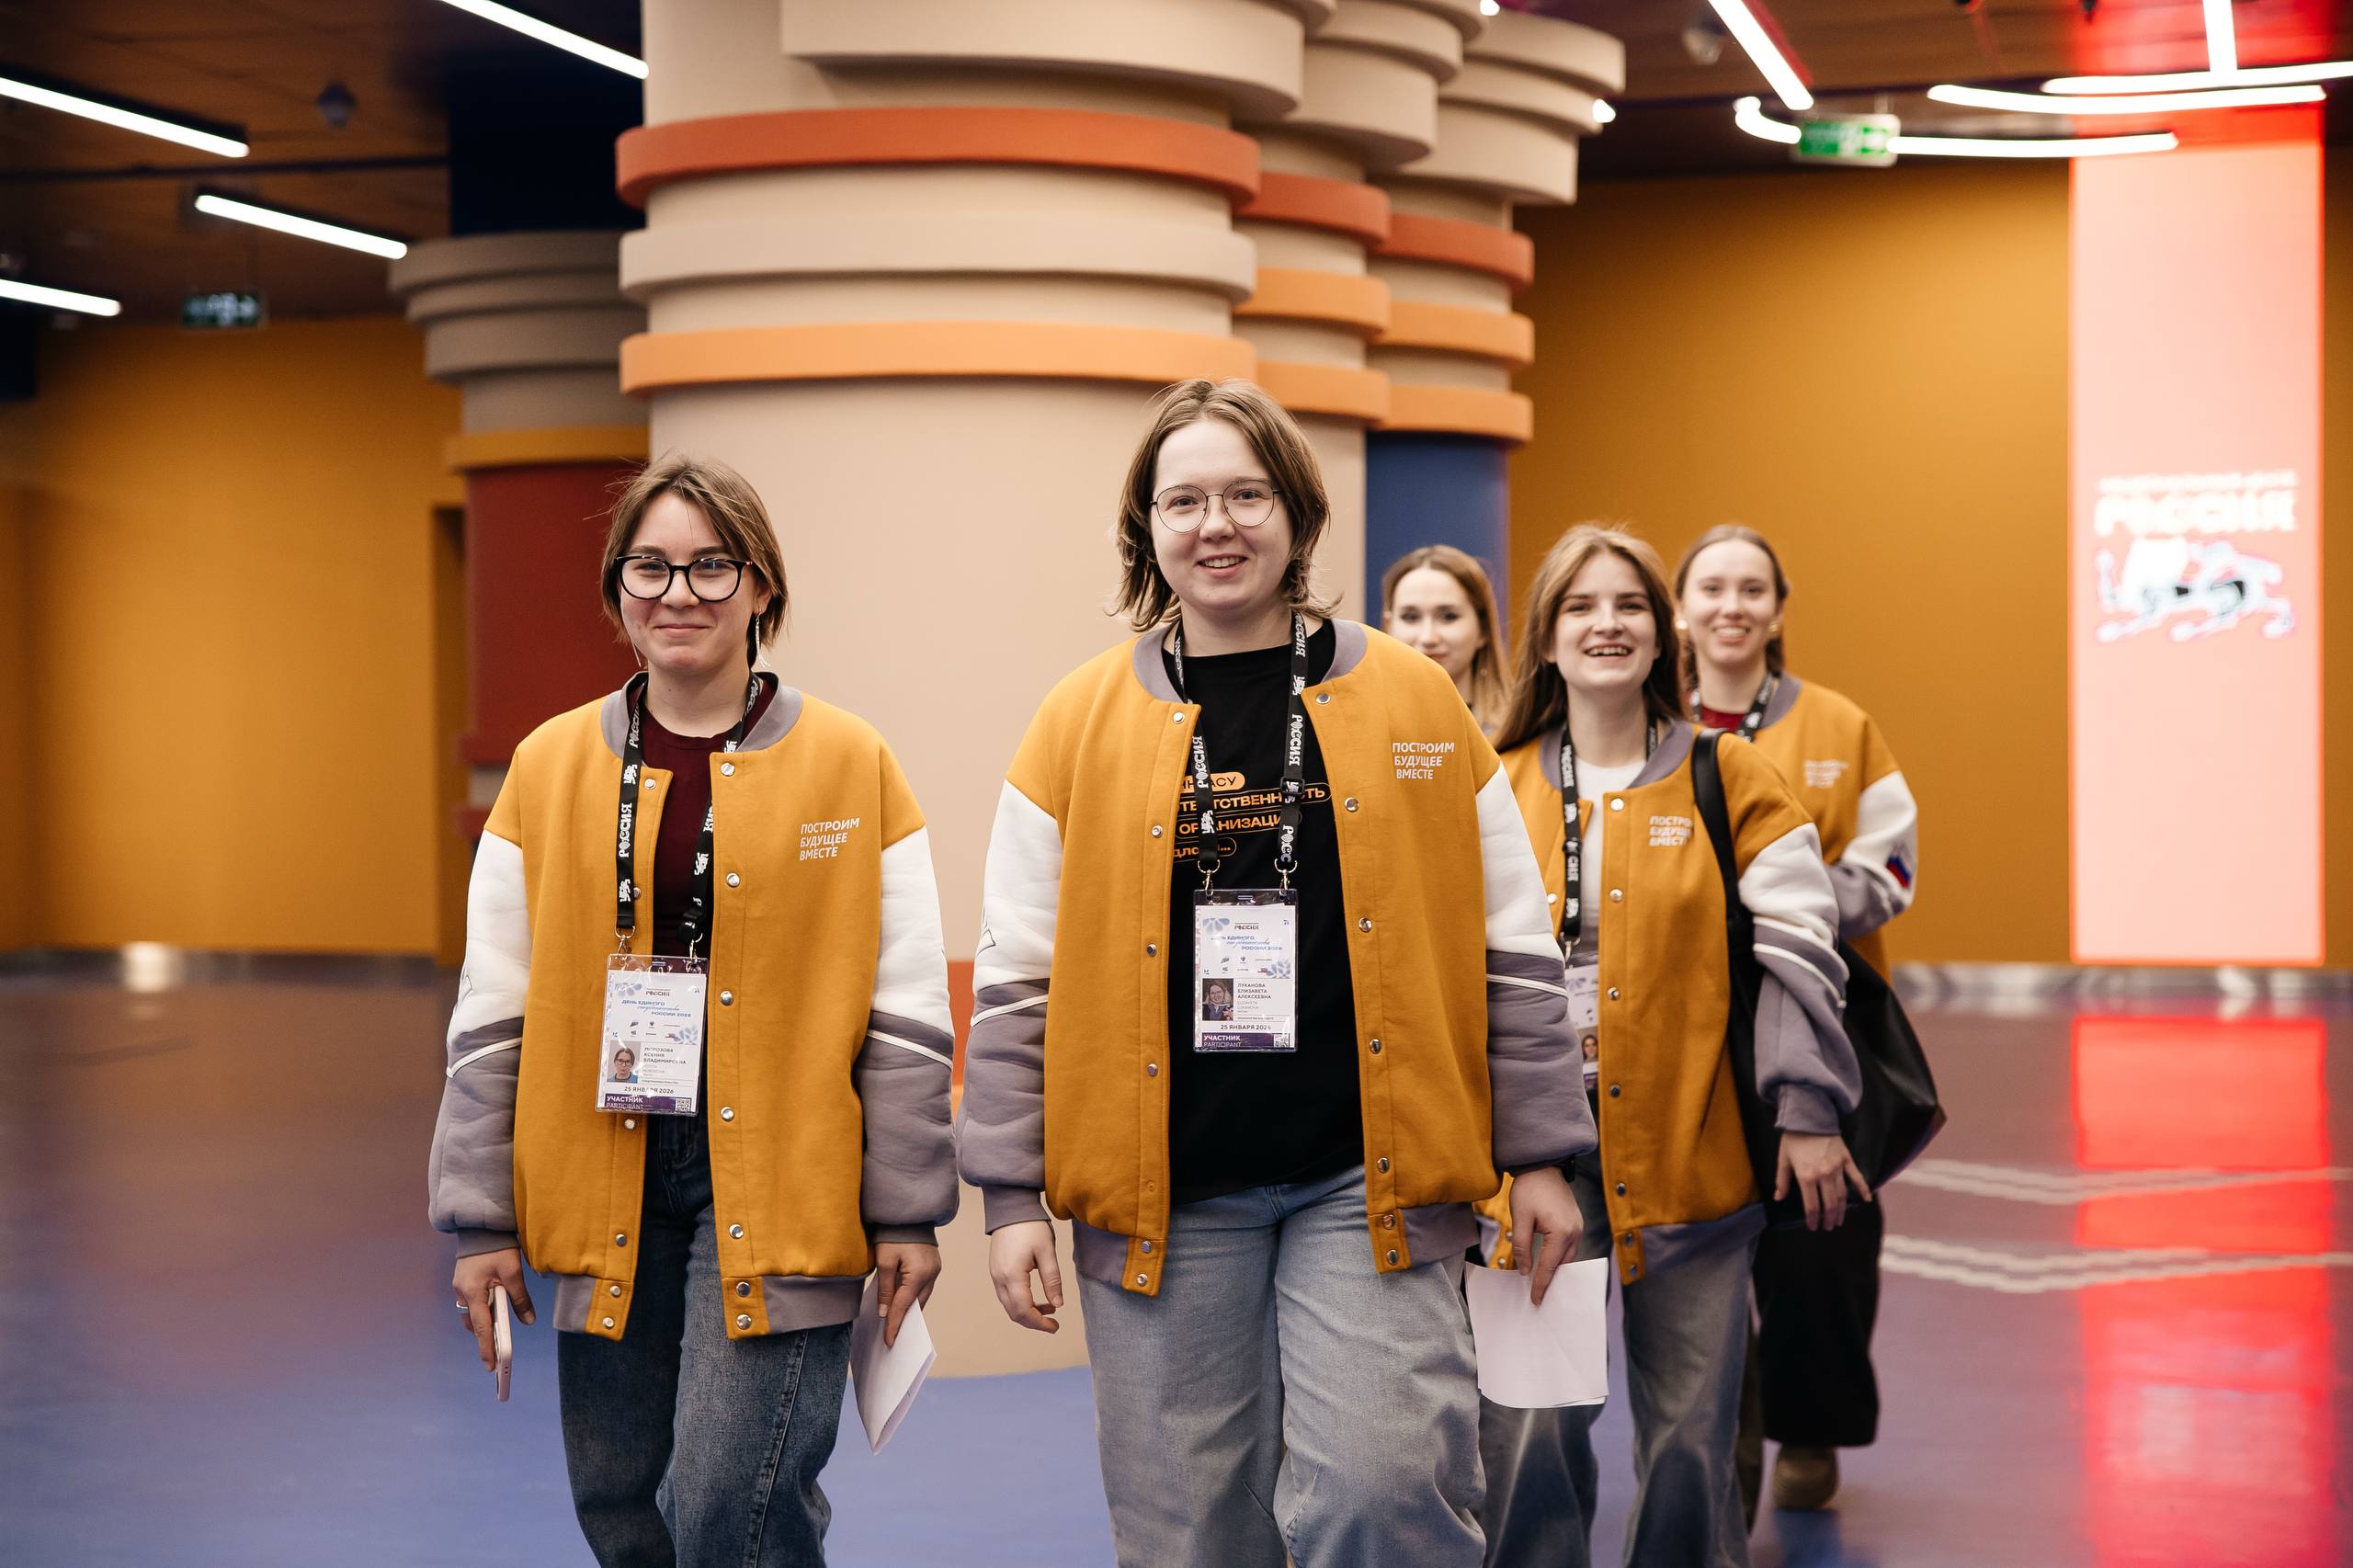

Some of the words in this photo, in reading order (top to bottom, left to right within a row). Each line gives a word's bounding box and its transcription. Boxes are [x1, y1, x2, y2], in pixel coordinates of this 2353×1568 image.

[1294, 613, 1306, 657] ОССИЯ
[629, 701, 641, 748] РОССИ
[1289, 714, 1303, 766] РОССИЯ
[1392, 742, 1455, 754] ПОСТРОИМ
[1194, 735, 1210, 789] РОССИЯ
[1394, 756, 1443, 768] БУДУЩЕЕ
[1396, 768, 1434, 779] ВМЕСТЕ
[619, 803, 632, 858] РОССИЯ
[801, 817, 860, 834] ПОСТРОИМ
[800, 833, 848, 848] БУДУЩЕЕ
[799, 846, 839, 860] ВМЕСТЕ
